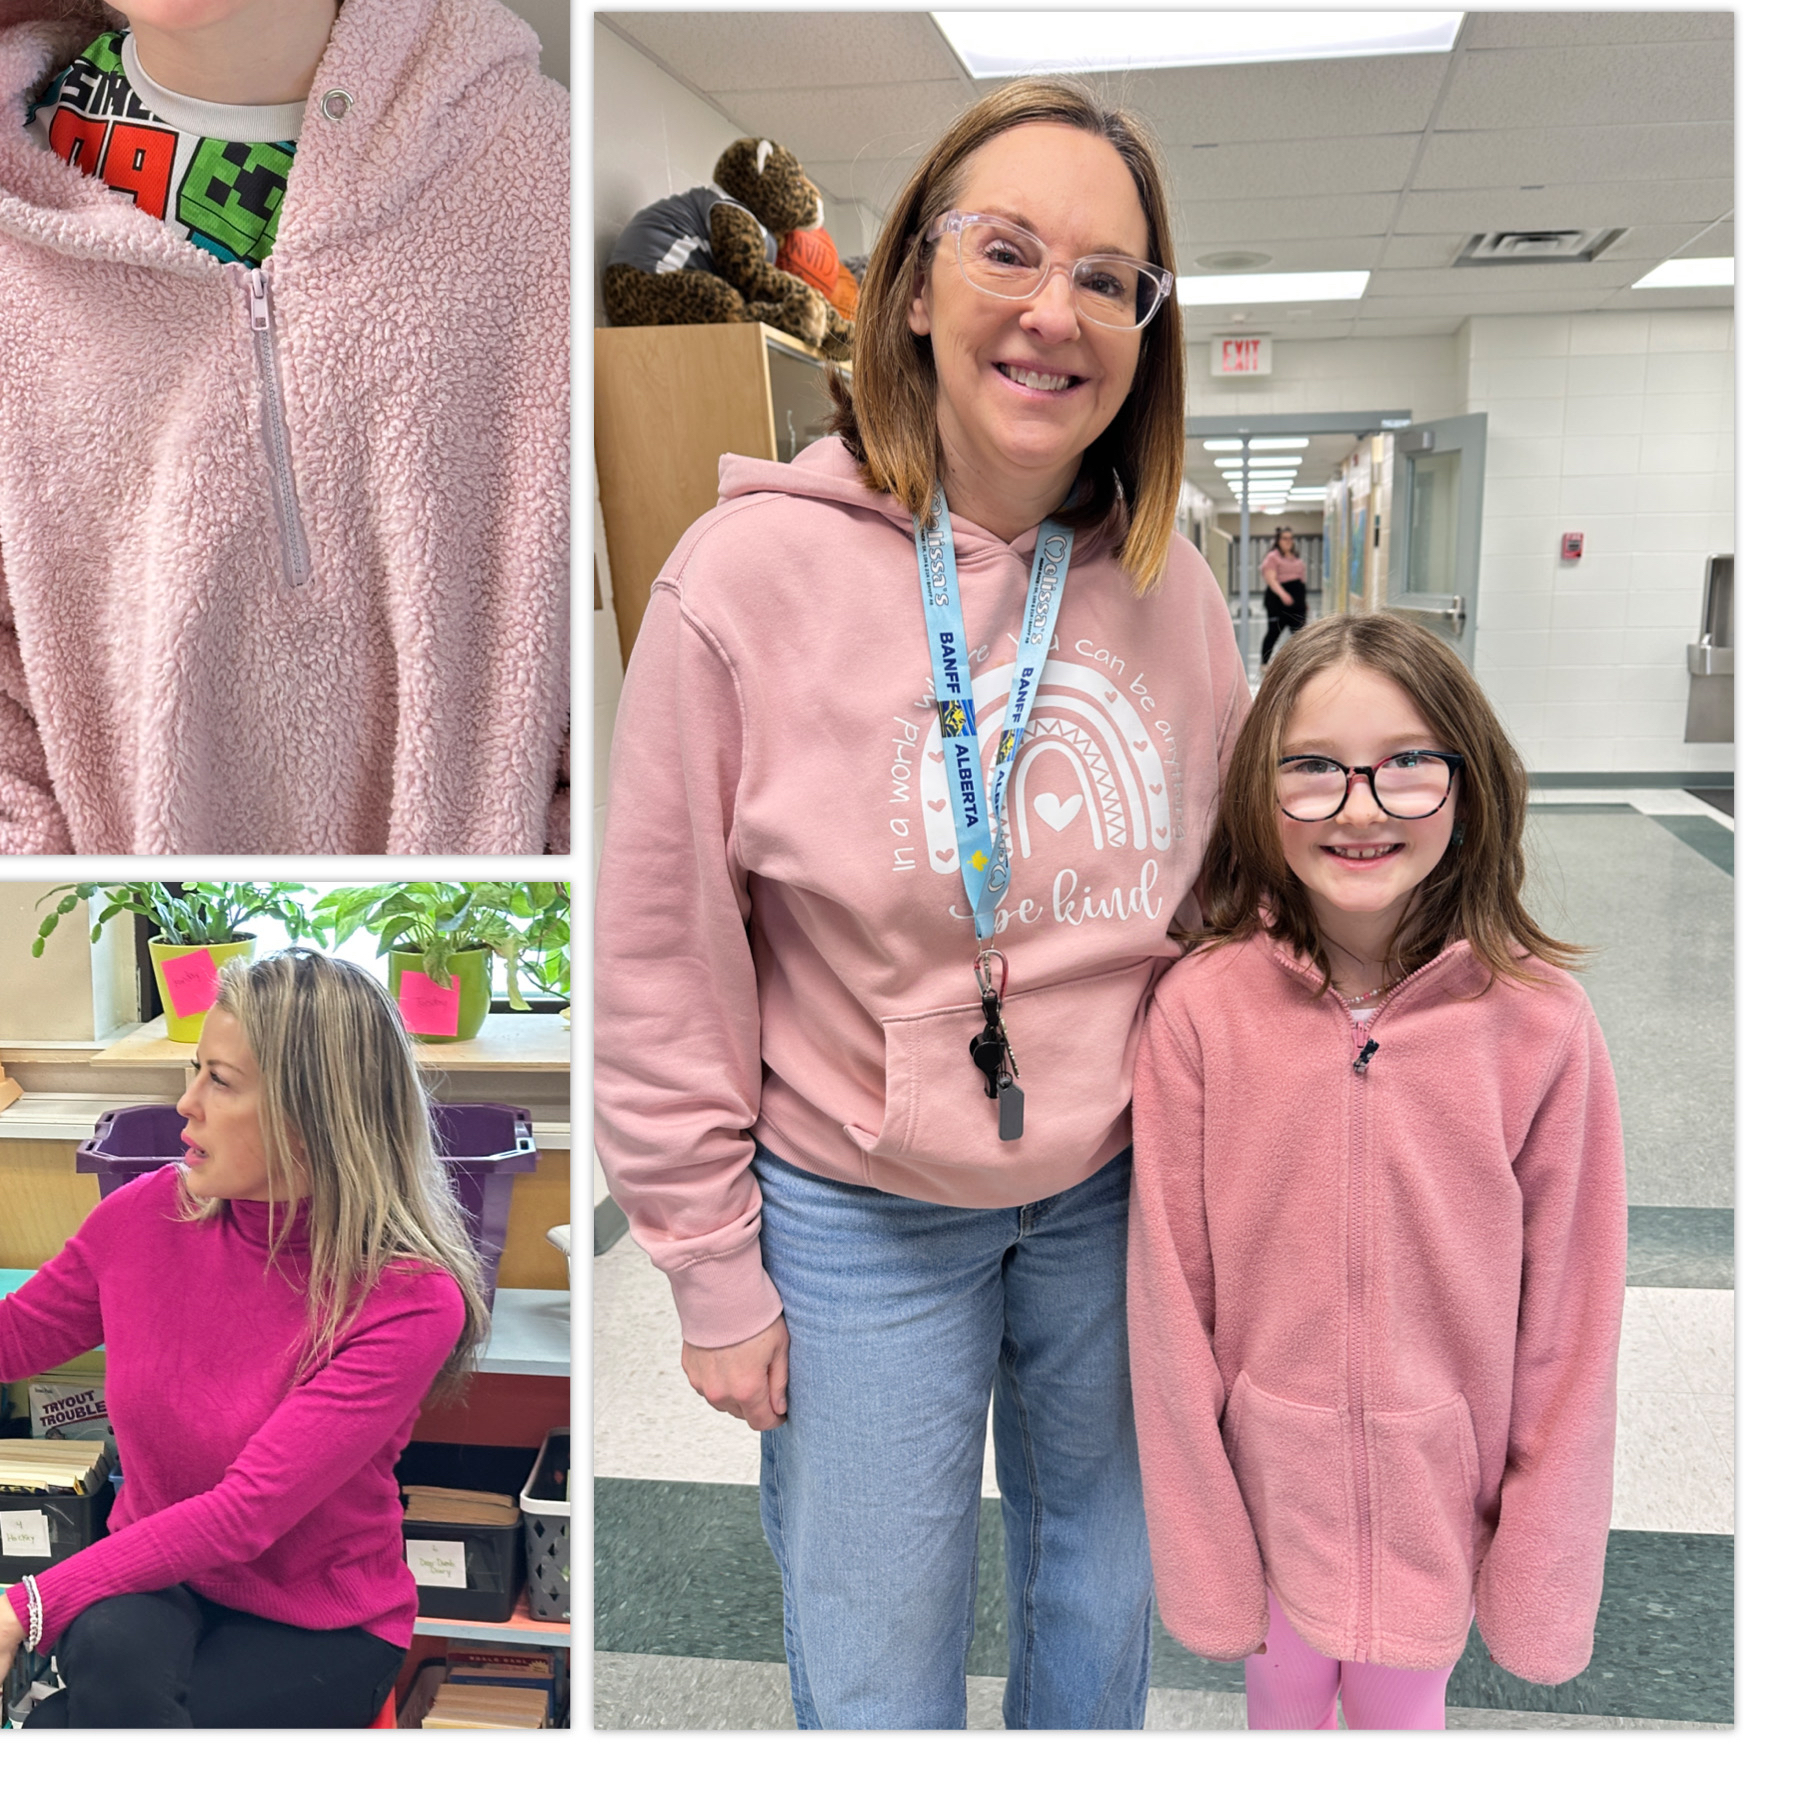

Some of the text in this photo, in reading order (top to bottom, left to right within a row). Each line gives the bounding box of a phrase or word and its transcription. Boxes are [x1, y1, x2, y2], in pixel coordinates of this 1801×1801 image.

[1222, 339, 1261, 372] EXIT
[940, 632, 960, 694] BANFF
[1075, 639, 1126, 675] can
[1012, 668, 1034, 723] BANFF
[1130, 673, 1155, 712] be
[890, 717, 920, 803] world
[955, 744, 979, 828] ALBERTA
[1155, 720, 1186, 841] anything
[890, 818, 910, 837] a
[892, 849, 915, 871] In
[1053, 859, 1162, 926] kind
[40, 1400, 106, 1426] TROUBLE
[43, 1390, 95, 1413] TRYOUT
